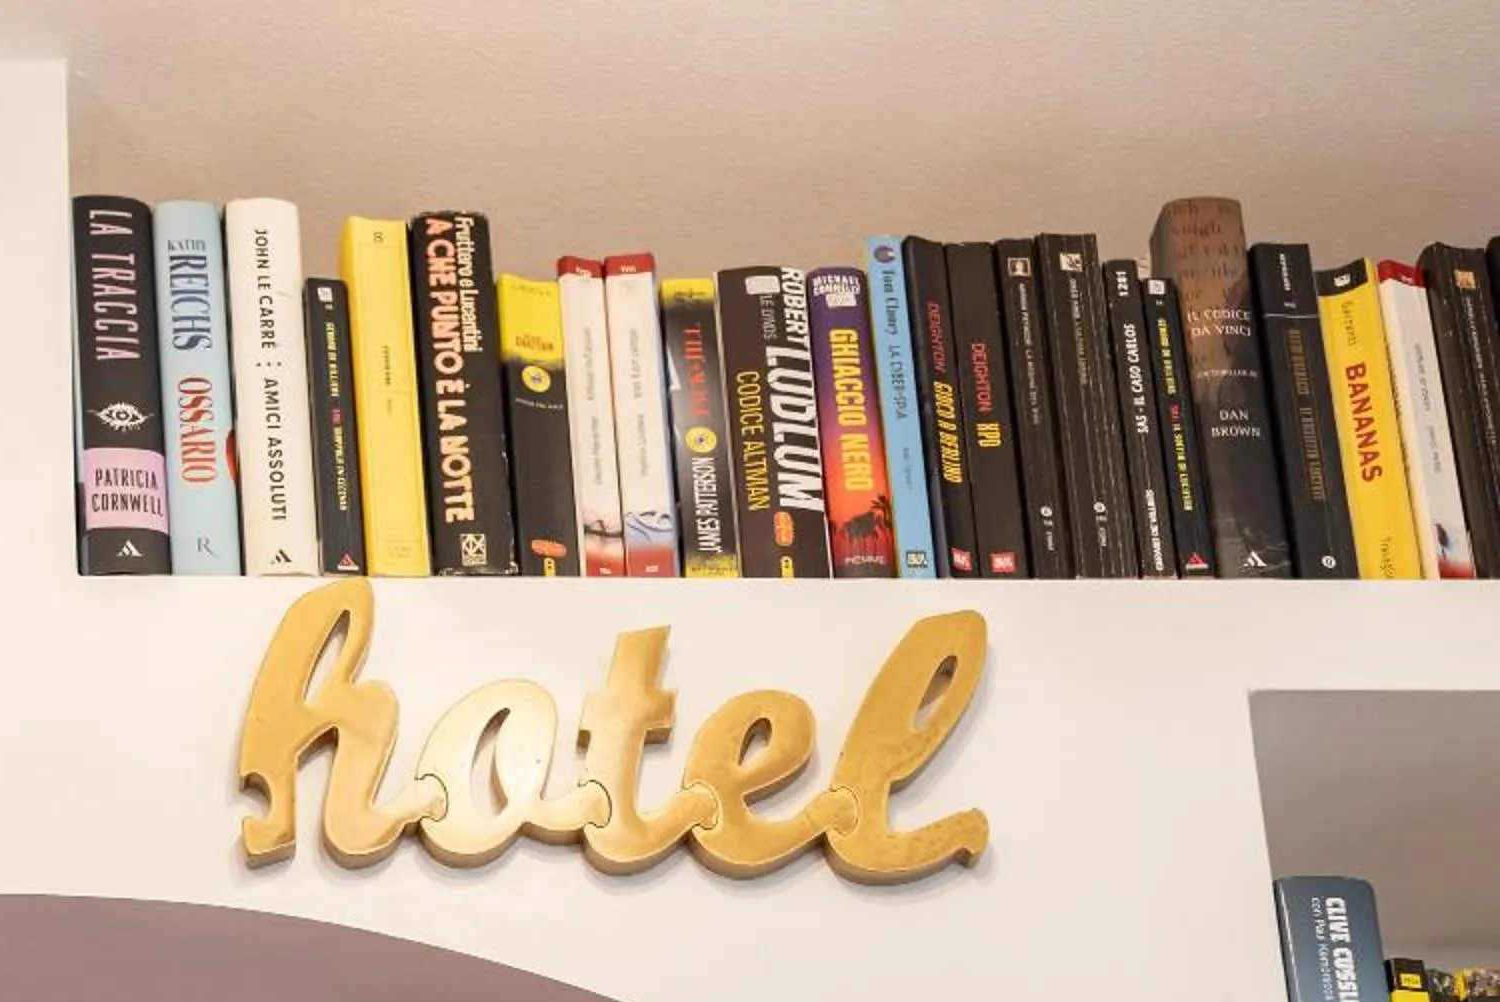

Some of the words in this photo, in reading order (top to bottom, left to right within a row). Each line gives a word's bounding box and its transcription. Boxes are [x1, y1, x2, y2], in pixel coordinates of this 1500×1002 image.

[88, 210, 134, 235] LA
[425, 218, 451, 235] A
[254, 228, 270, 270] JOHN
[425, 238, 458, 288] CHE
[454, 217, 478, 276] Fruttero
[169, 255, 212, 351] REICHS
[257, 275, 272, 291] LE
[458, 278, 474, 288] e
[882, 269, 895, 293] Tom
[91, 253, 141, 361] TRACCIA
[460, 289, 484, 352] Lucentini
[781, 268, 809, 345] ROBERT
[884, 298, 899, 336] Clancy
[429, 291, 463, 374] PUNTO
[887, 345, 900, 358] LA
[926, 302, 946, 372] DEIGHTON
[1123, 323, 1139, 364] CARLOS
[1214, 325, 1254, 338] VINCI
[435, 379, 470, 395] È
[828, 329, 867, 426] GHIACCIO
[889, 360, 908, 420] CYBER-SPIA
[932, 381, 954, 417] GIOCO
[971, 342, 990, 412] DEIGHTON
[1128, 366, 1143, 396] CASO
[263, 378, 281, 431] AMICI
[435, 399, 466, 431] LA
[735, 371, 763, 435] CODICE
[937, 420, 956, 430] A
[1136, 416, 1148, 433] SAS
[1219, 409, 1249, 422] DAN
[1345, 361, 1383, 482] BANANAS
[178, 378, 216, 483] OSSARIO
[765, 346, 824, 511] LUDLUM
[1211, 425, 1262, 439] BROWN
[94, 469, 159, 491] PATRICIA
[267, 437, 287, 521] ASSOLUTI
[439, 435, 474, 523] NOTTE
[742, 441, 769, 511] ALTMAN
[839, 434, 873, 491] NERO
[938, 432, 962, 484] BERLINO
[92, 493, 164, 517] CORNWELL
[690, 457, 721, 515] PATTERSON
[696, 517, 722, 555] JAMES
[239, 577, 990, 885] hotel
[1311, 897, 1323, 917] con
[1324, 897, 1352, 942] CLIVE
[1314, 919, 1328, 941] Paul
